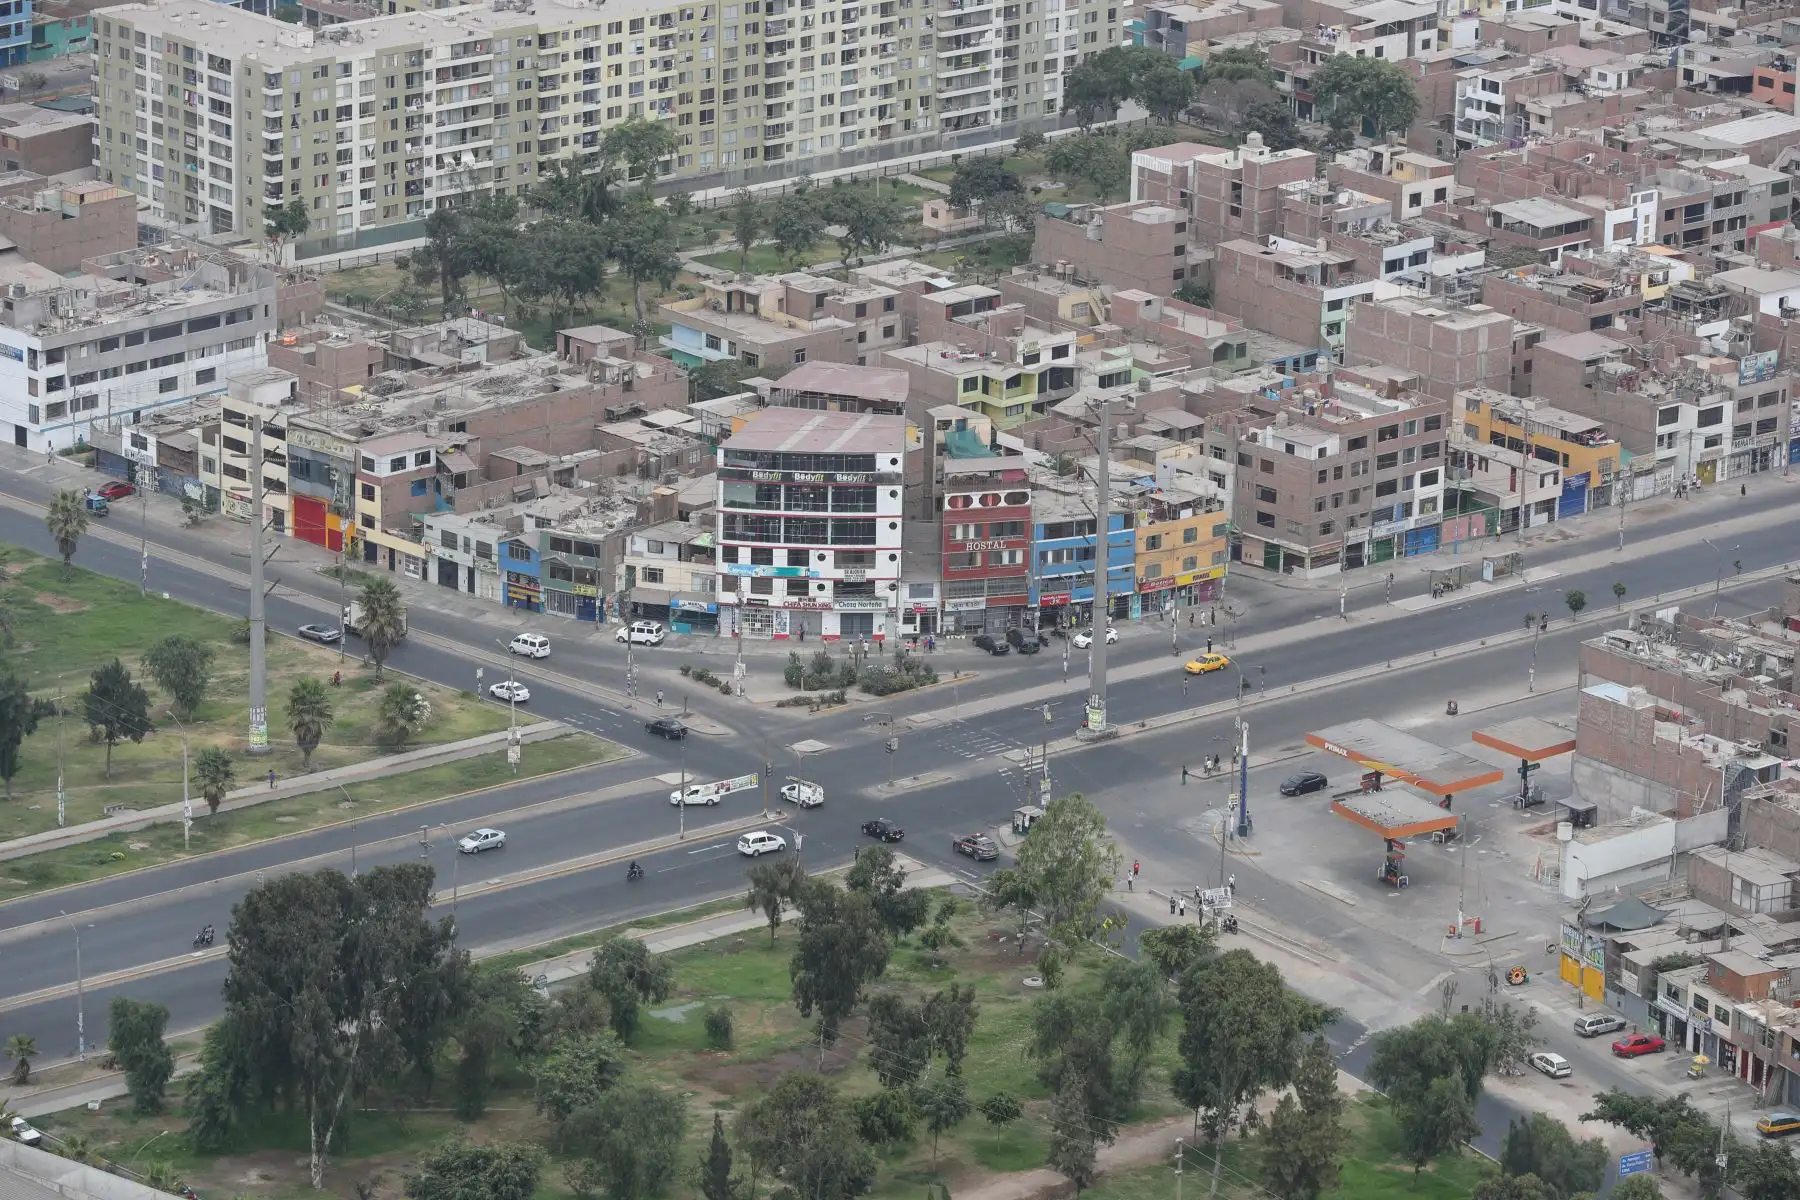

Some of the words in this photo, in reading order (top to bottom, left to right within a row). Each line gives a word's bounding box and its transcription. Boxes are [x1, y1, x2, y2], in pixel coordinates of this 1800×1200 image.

[752, 471, 782, 481] Bodyfit
[794, 472, 824, 482] Bodyfit
[836, 473, 866, 483] Bodyfit
[966, 541, 1007, 550] HOSTAL
[1324, 742, 1348, 756] PRIMAX
